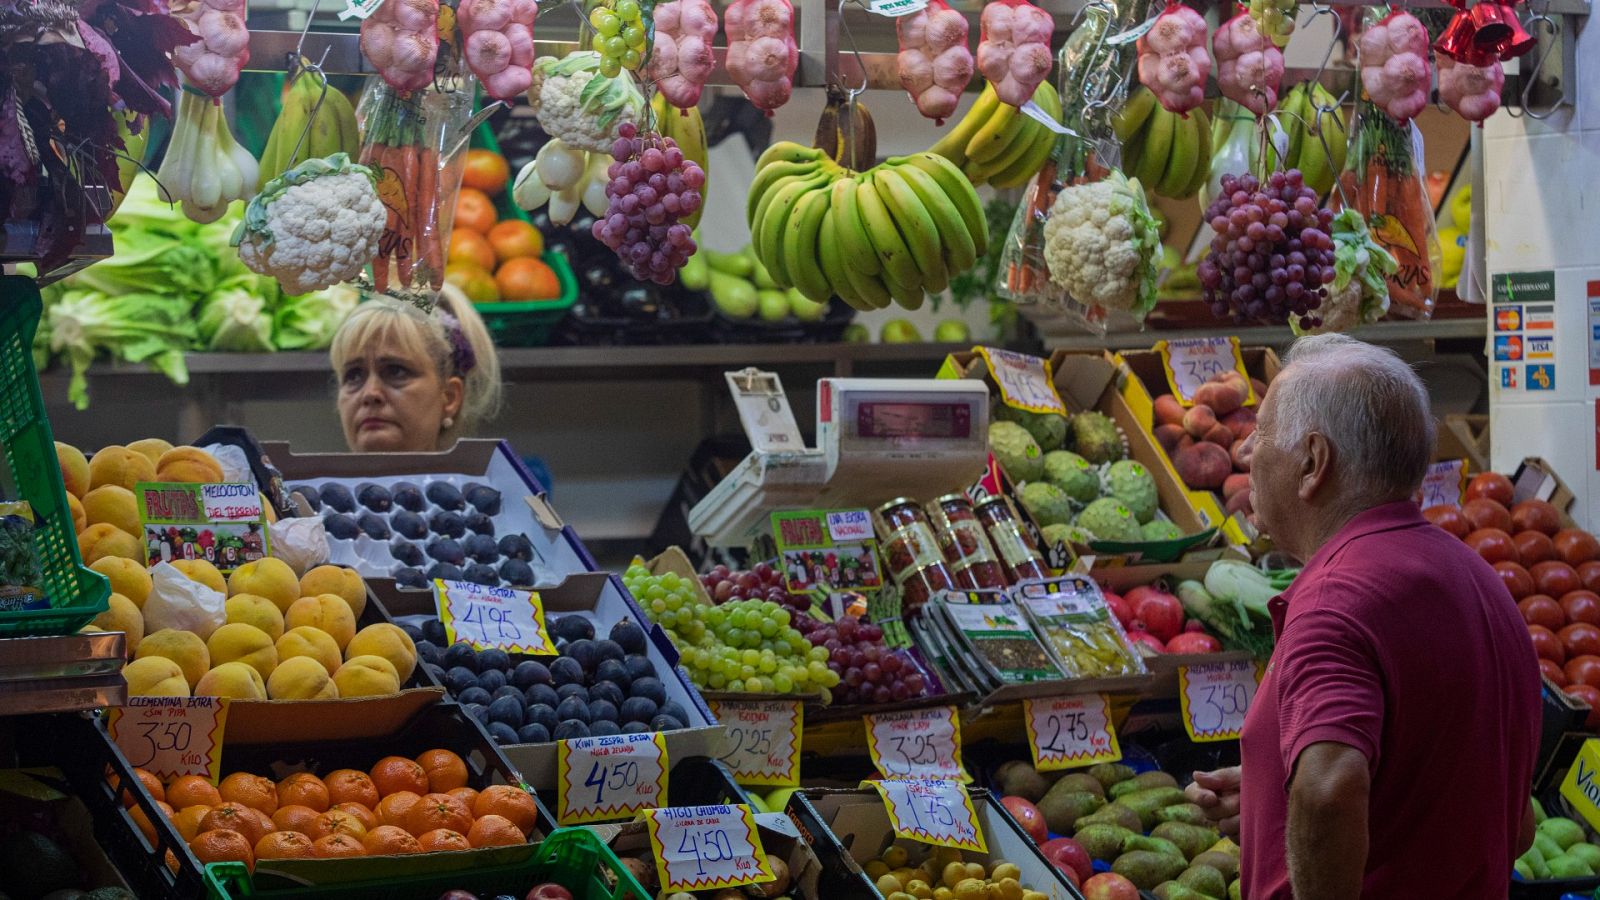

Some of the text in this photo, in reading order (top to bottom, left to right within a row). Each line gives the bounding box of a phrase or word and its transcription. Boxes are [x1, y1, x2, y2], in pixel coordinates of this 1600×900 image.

[1532, 343, 1549, 352] VISA
[203, 484, 256, 498] MELOCOTON
[143, 489, 199, 519] FRUTAS
[206, 505, 261, 519] DEL TERRENO
[829, 511, 868, 524] UVA EXTRA
[779, 517, 825, 546] FRUTAS
[834, 525, 865, 537] NACIONAL
[185, 543, 193, 560] 4
[207, 547, 215, 560] 9
[228, 547, 235, 559] 5
[455, 582, 482, 594] HIGO
[488, 585, 517, 599] EXTRA
[462, 602, 521, 643] 4'95
[129, 696, 212, 708] CLEMENTINA EXTRA
[1193, 683, 1248, 732] 3'50
[168, 708, 187, 717] PIPA
[1041, 711, 1088, 754] 2'75
[131, 721, 192, 768] 3'50
[575, 738, 594, 750] KIWI
[628, 733, 651, 743] EXTRA
[717, 727, 772, 769] 2'25
[590, 745, 635, 757] NUEVA ZELANDA
[886, 733, 938, 776] 3'25
[584, 760, 639, 805] 4'50
[663, 804, 732, 820] HIGO CHUMBO
[906, 789, 954, 831] 1'75
[697, 818, 705, 826] DE
[677, 828, 733, 876] 4'50
